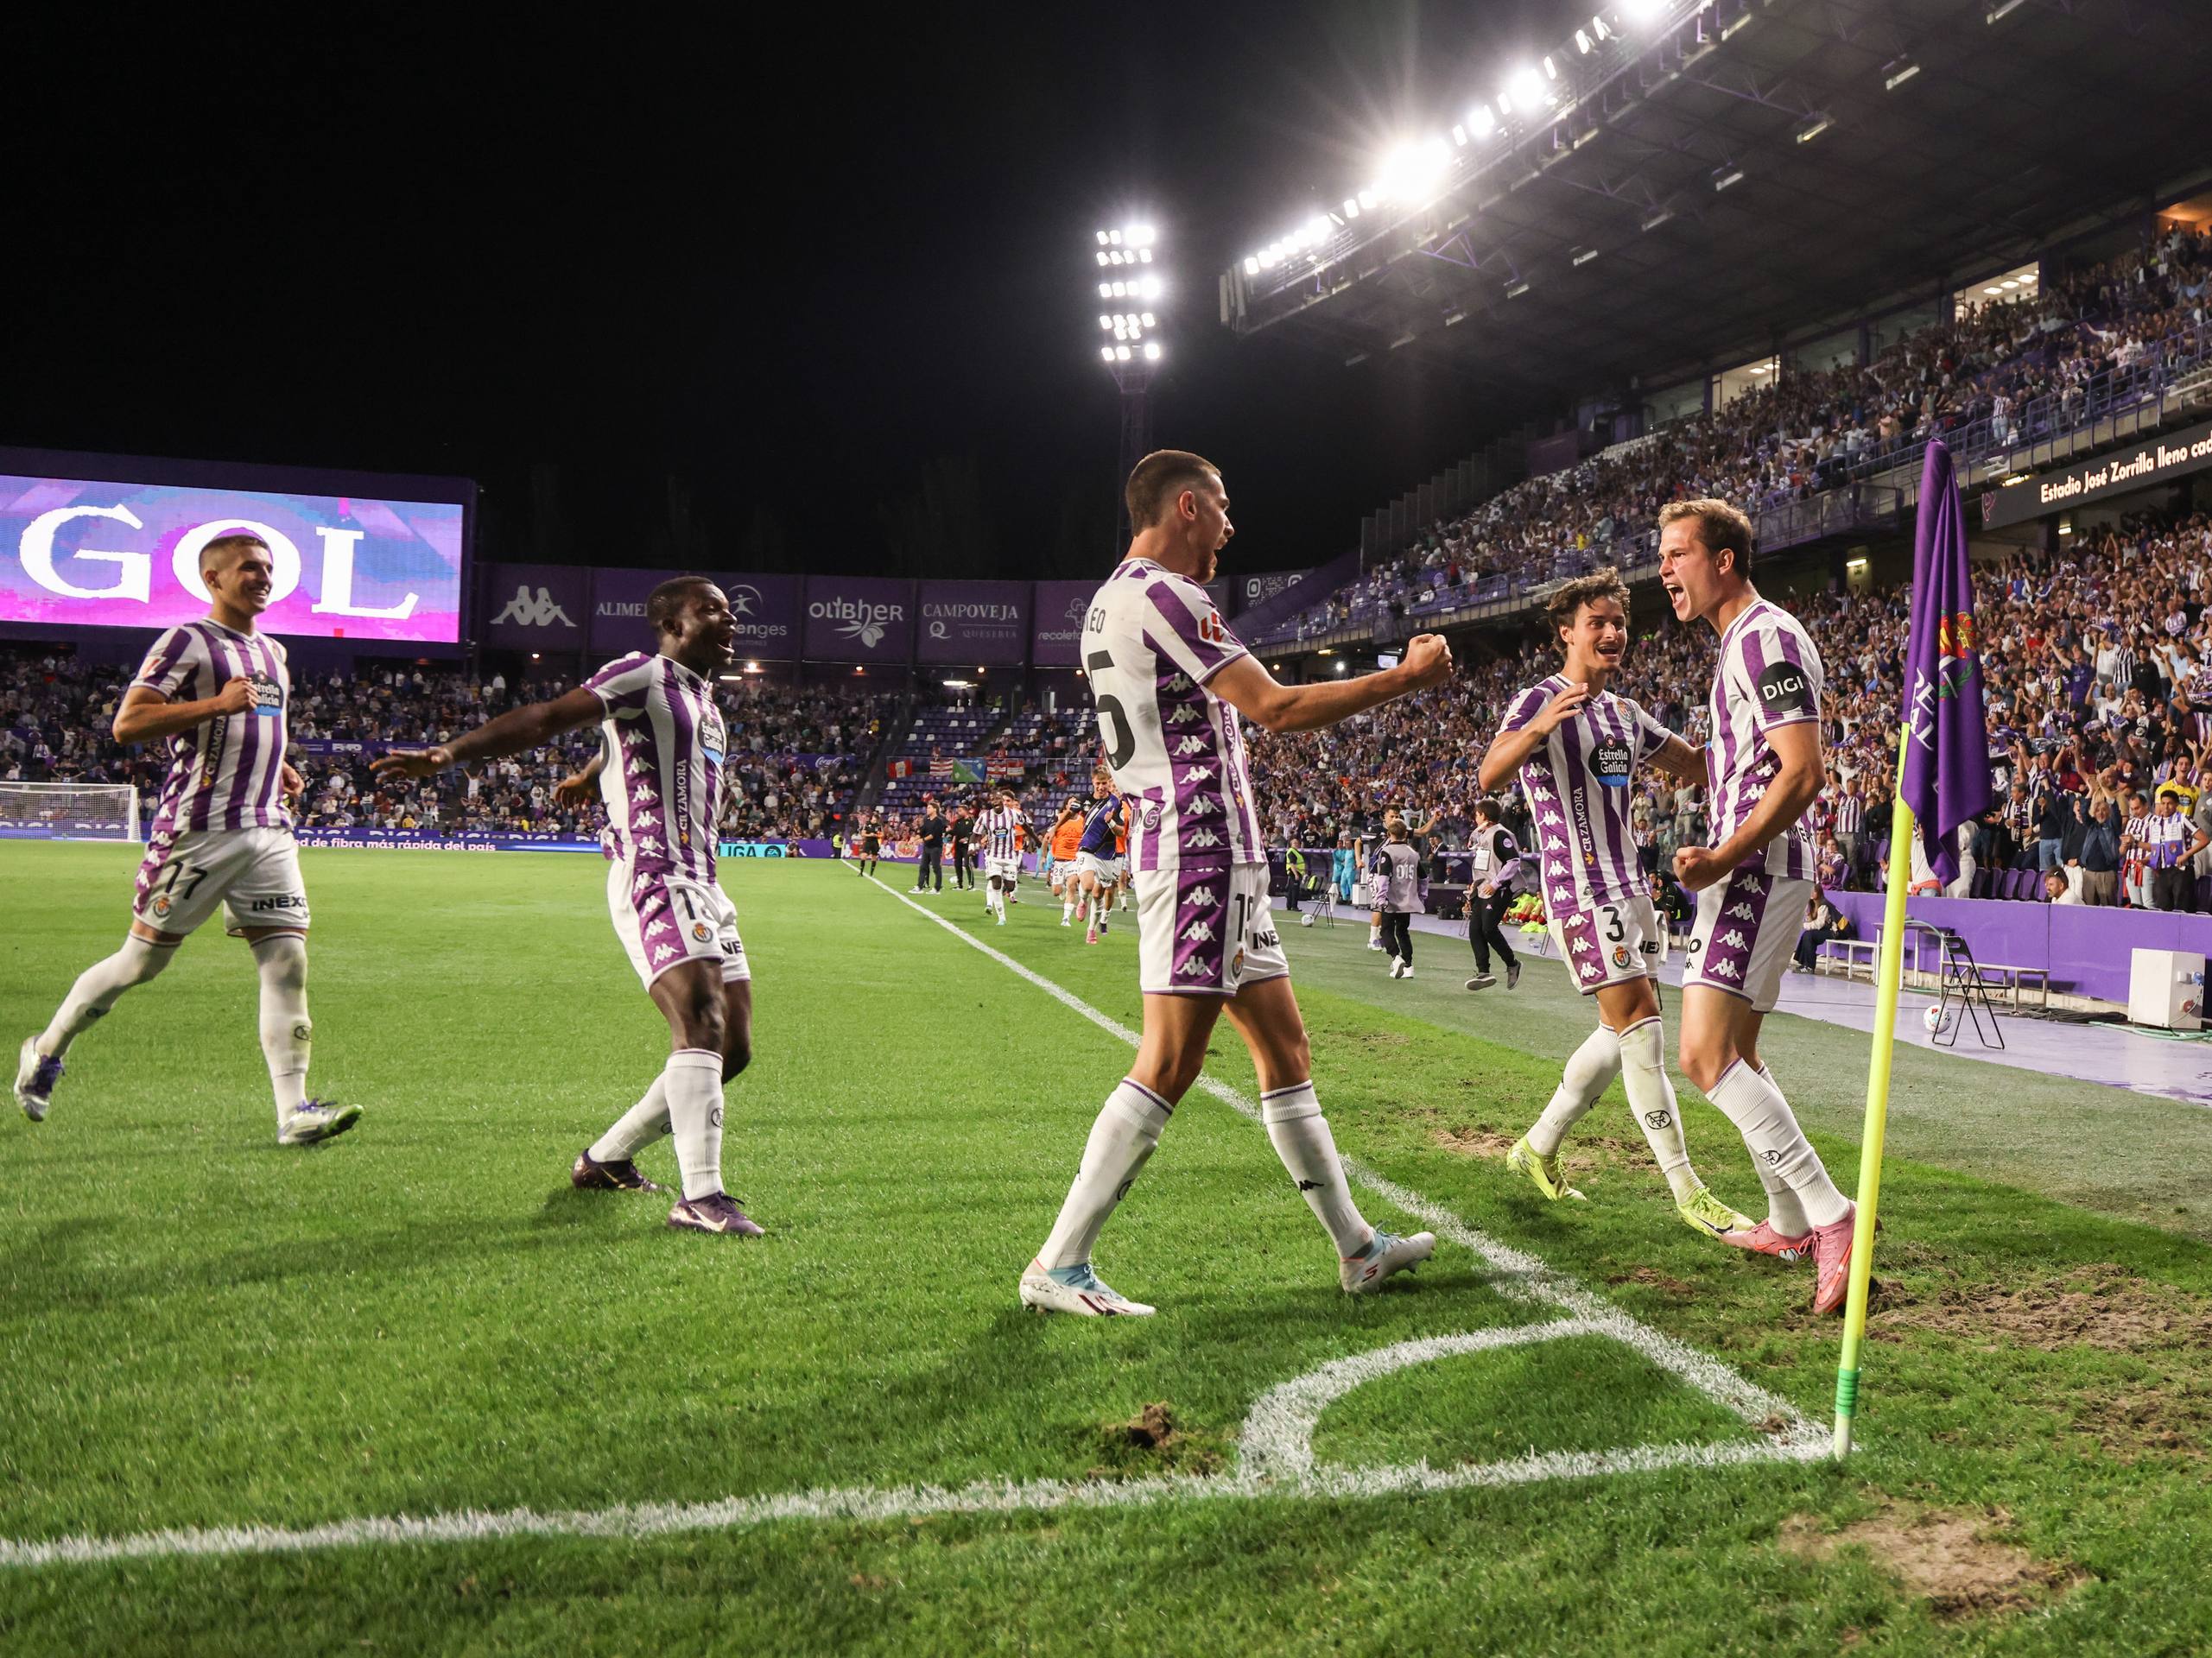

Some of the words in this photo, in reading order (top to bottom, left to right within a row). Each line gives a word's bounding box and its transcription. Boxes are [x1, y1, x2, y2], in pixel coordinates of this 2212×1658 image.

[2040, 475, 2082, 503] Estadio
[2083, 467, 2107, 494] José
[2110, 451, 2154, 483] Zorrilla
[2157, 445, 2188, 468] lleno
[19, 503, 420, 620] GOL
[922, 603, 1019, 621] CAMPOVEJA
[734, 624, 788, 639] enges
[1762, 675, 1804, 701] DIGI
[257, 693, 280, 706] alicia
[1598, 749, 1628, 762] Estrella
[1600, 762, 1628, 774] Galicia
[676, 759, 688, 813] ZAMORA
[1573, 786, 1589, 836] ZAMORA
[311, 838, 328, 847] de
[331, 838, 364, 849] fibra
[367, 838, 395, 850] más
[397, 839, 441, 851] rápida
[444, 841, 466, 851] del
[468, 841, 497, 851] país
[1582, 836, 1593, 852] CR
[1602, 906, 1625, 942] 3
[1252, 929, 1281, 950] INE
